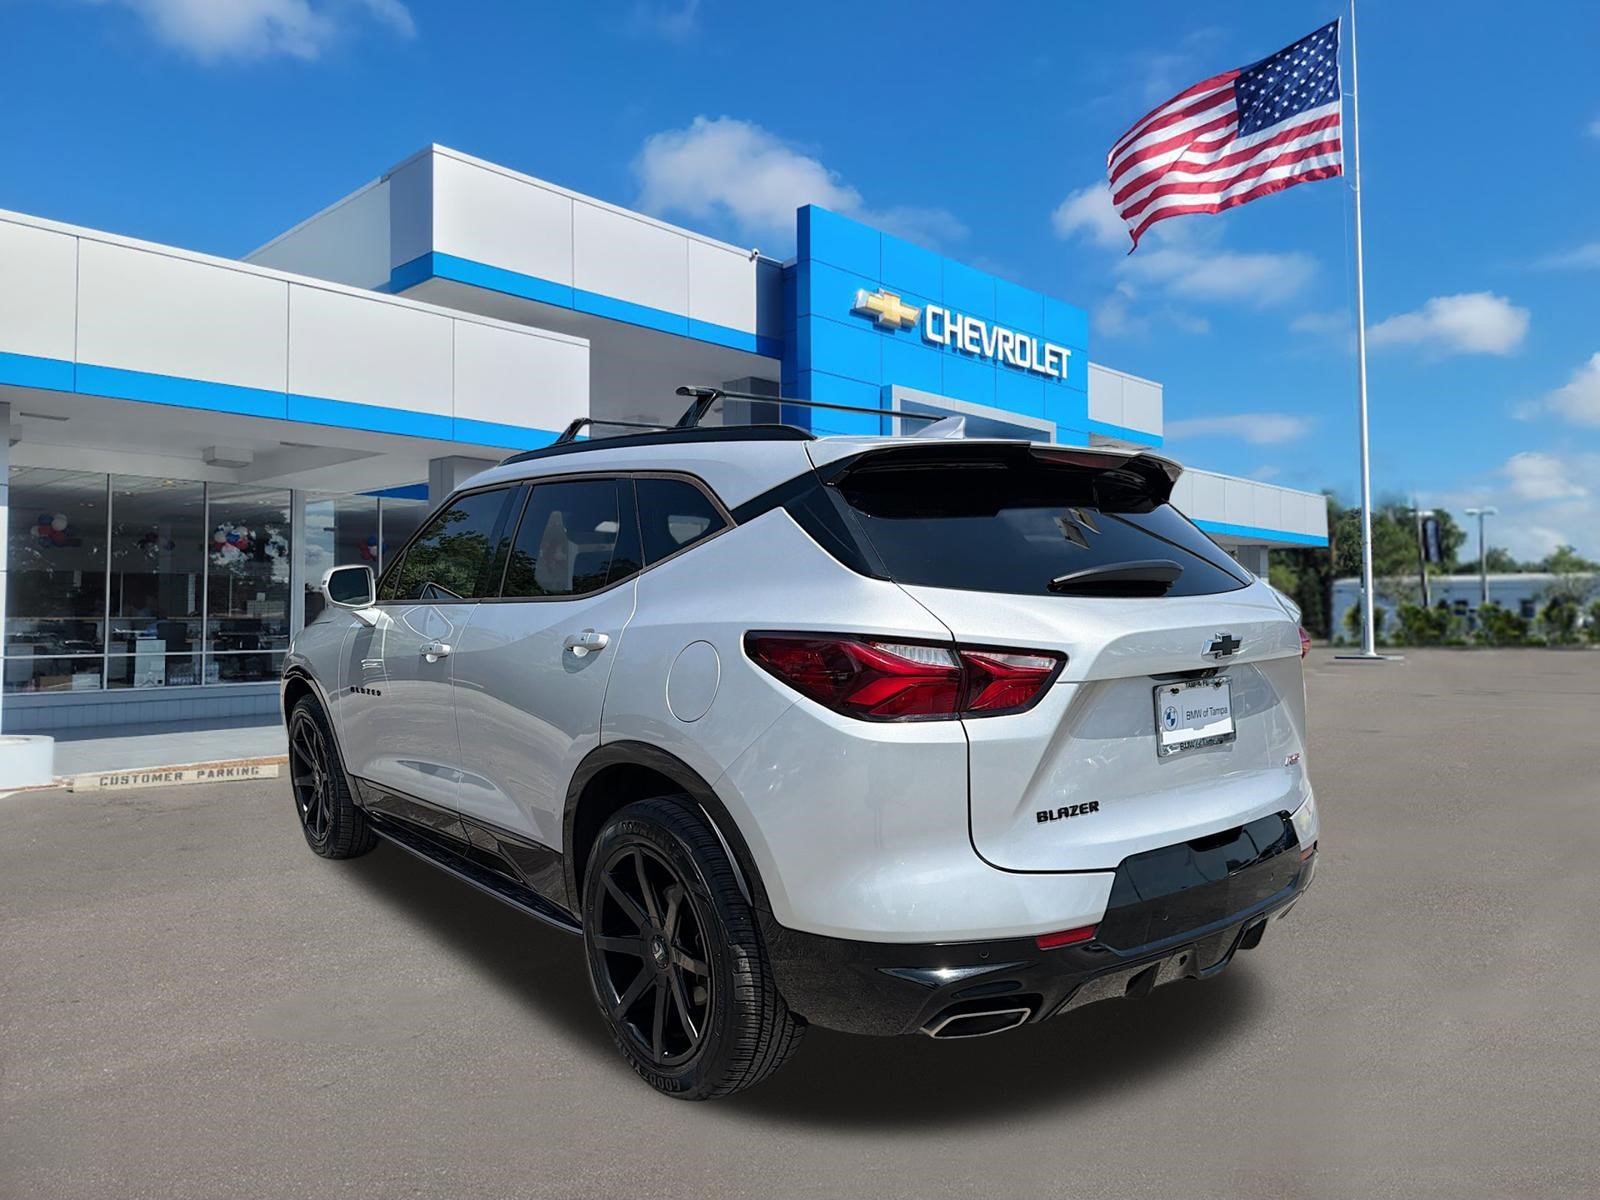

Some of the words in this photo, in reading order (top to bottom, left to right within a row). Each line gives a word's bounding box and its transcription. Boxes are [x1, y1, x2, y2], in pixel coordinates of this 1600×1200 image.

[925, 303, 1072, 379] CHEVROLET
[1186, 709, 1202, 721] BMW
[1202, 707, 1209, 718] of
[1209, 706, 1229, 717] Tampa
[99, 771, 184, 787] CUSTOMER
[196, 766, 260, 780] PARKING
[1036, 800, 1100, 823] BLAZER
